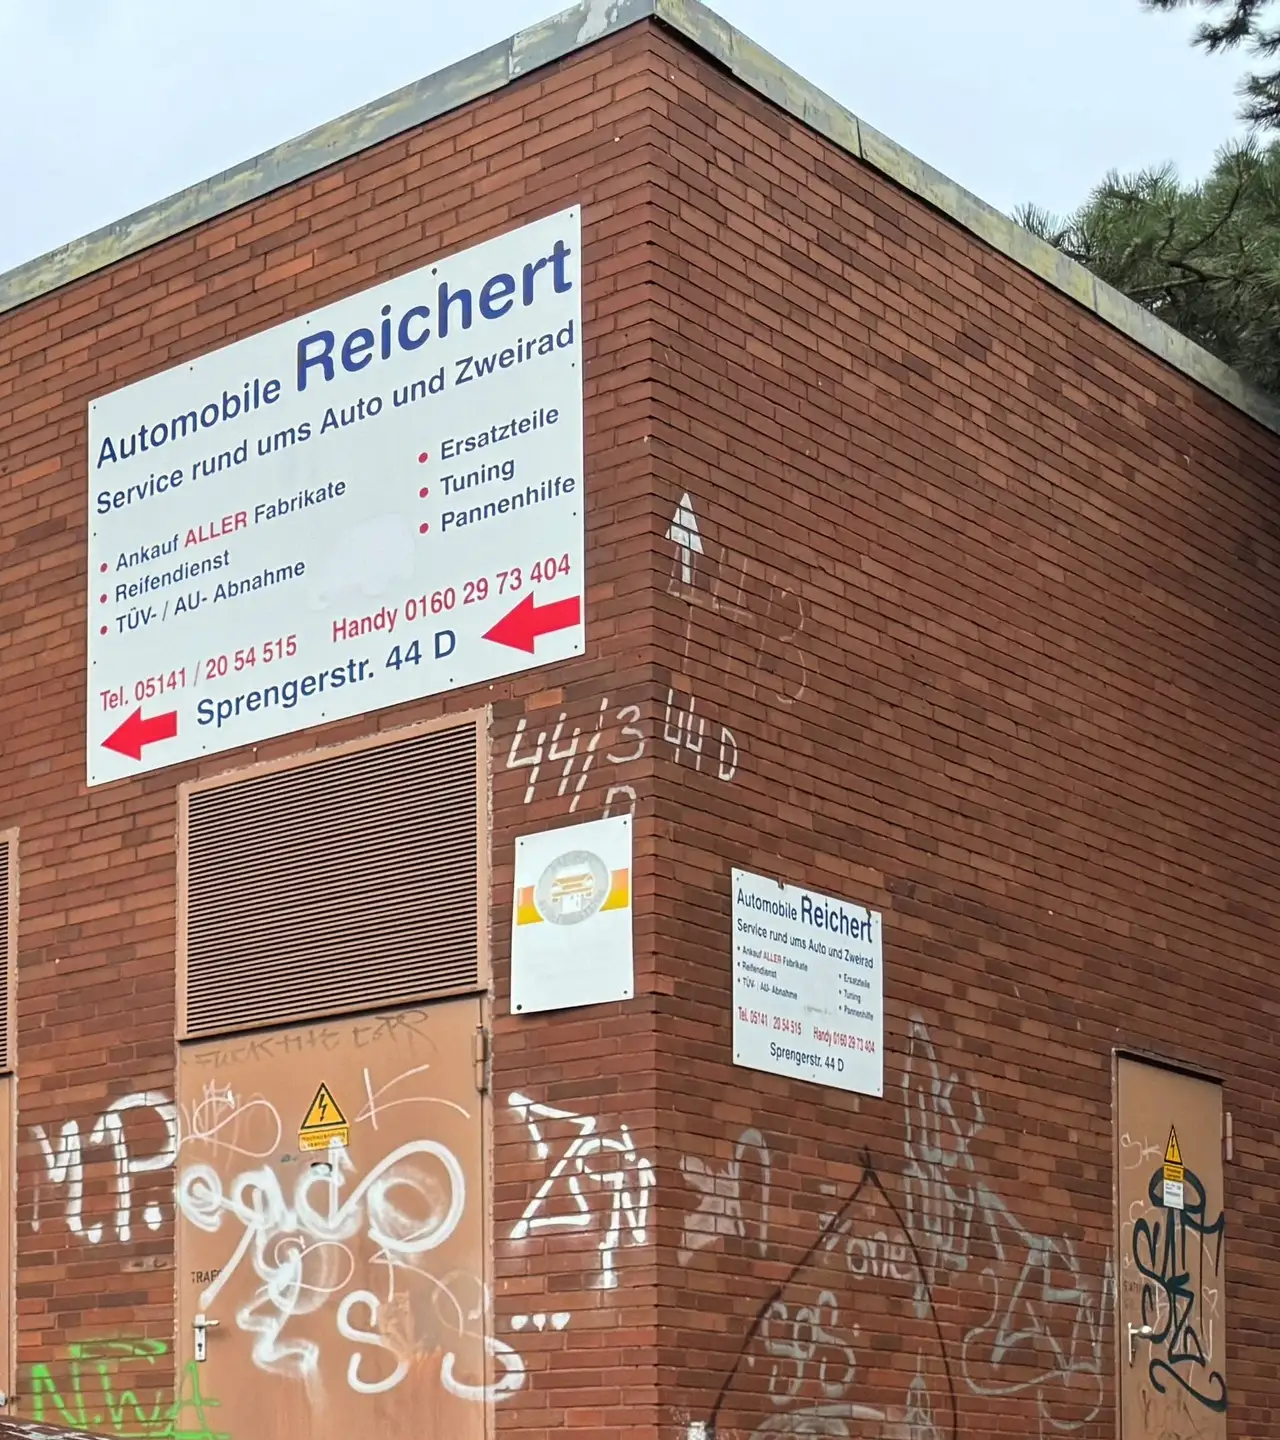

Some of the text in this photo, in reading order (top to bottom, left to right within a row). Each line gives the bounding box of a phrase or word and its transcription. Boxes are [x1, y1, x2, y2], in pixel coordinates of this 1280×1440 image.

[96, 240, 572, 469] Automobile Reichert
[97, 320, 574, 514] Service rund ums Auto und Zweirad
[441, 408, 559, 460] Ersatzteile
[440, 459, 515, 495] Tuning
[441, 477, 576, 532] Pannenhilfe
[115, 481, 347, 572] Ankauf ALLER Fabrikate
[115, 550, 230, 603] Reifendienst
[116, 606, 157, 634] TÜV-
[174, 591, 208, 615] AU-
[213, 561, 306, 603] Abnahme
[100, 686, 129, 711] Tel.
[134, 667, 187, 701] 05141
[206, 655, 228, 680] 20
[234, 646, 256, 671] 54
[263, 634, 297, 664] 515
[333, 606, 398, 642] Handy
[405, 587, 456, 621] 0160
[463, 577, 489, 605] 29
[496, 568, 522, 595] 73
[530, 553, 571, 583] 404
[197, 630, 456, 727] Sprengerstr. 44 D
[737, 888, 873, 943] Automobile Reichert
[737, 918, 874, 968] Service rund ums Auto und Zweirad
[770, 1042, 844, 1073] Sprengerstr. 44 D
